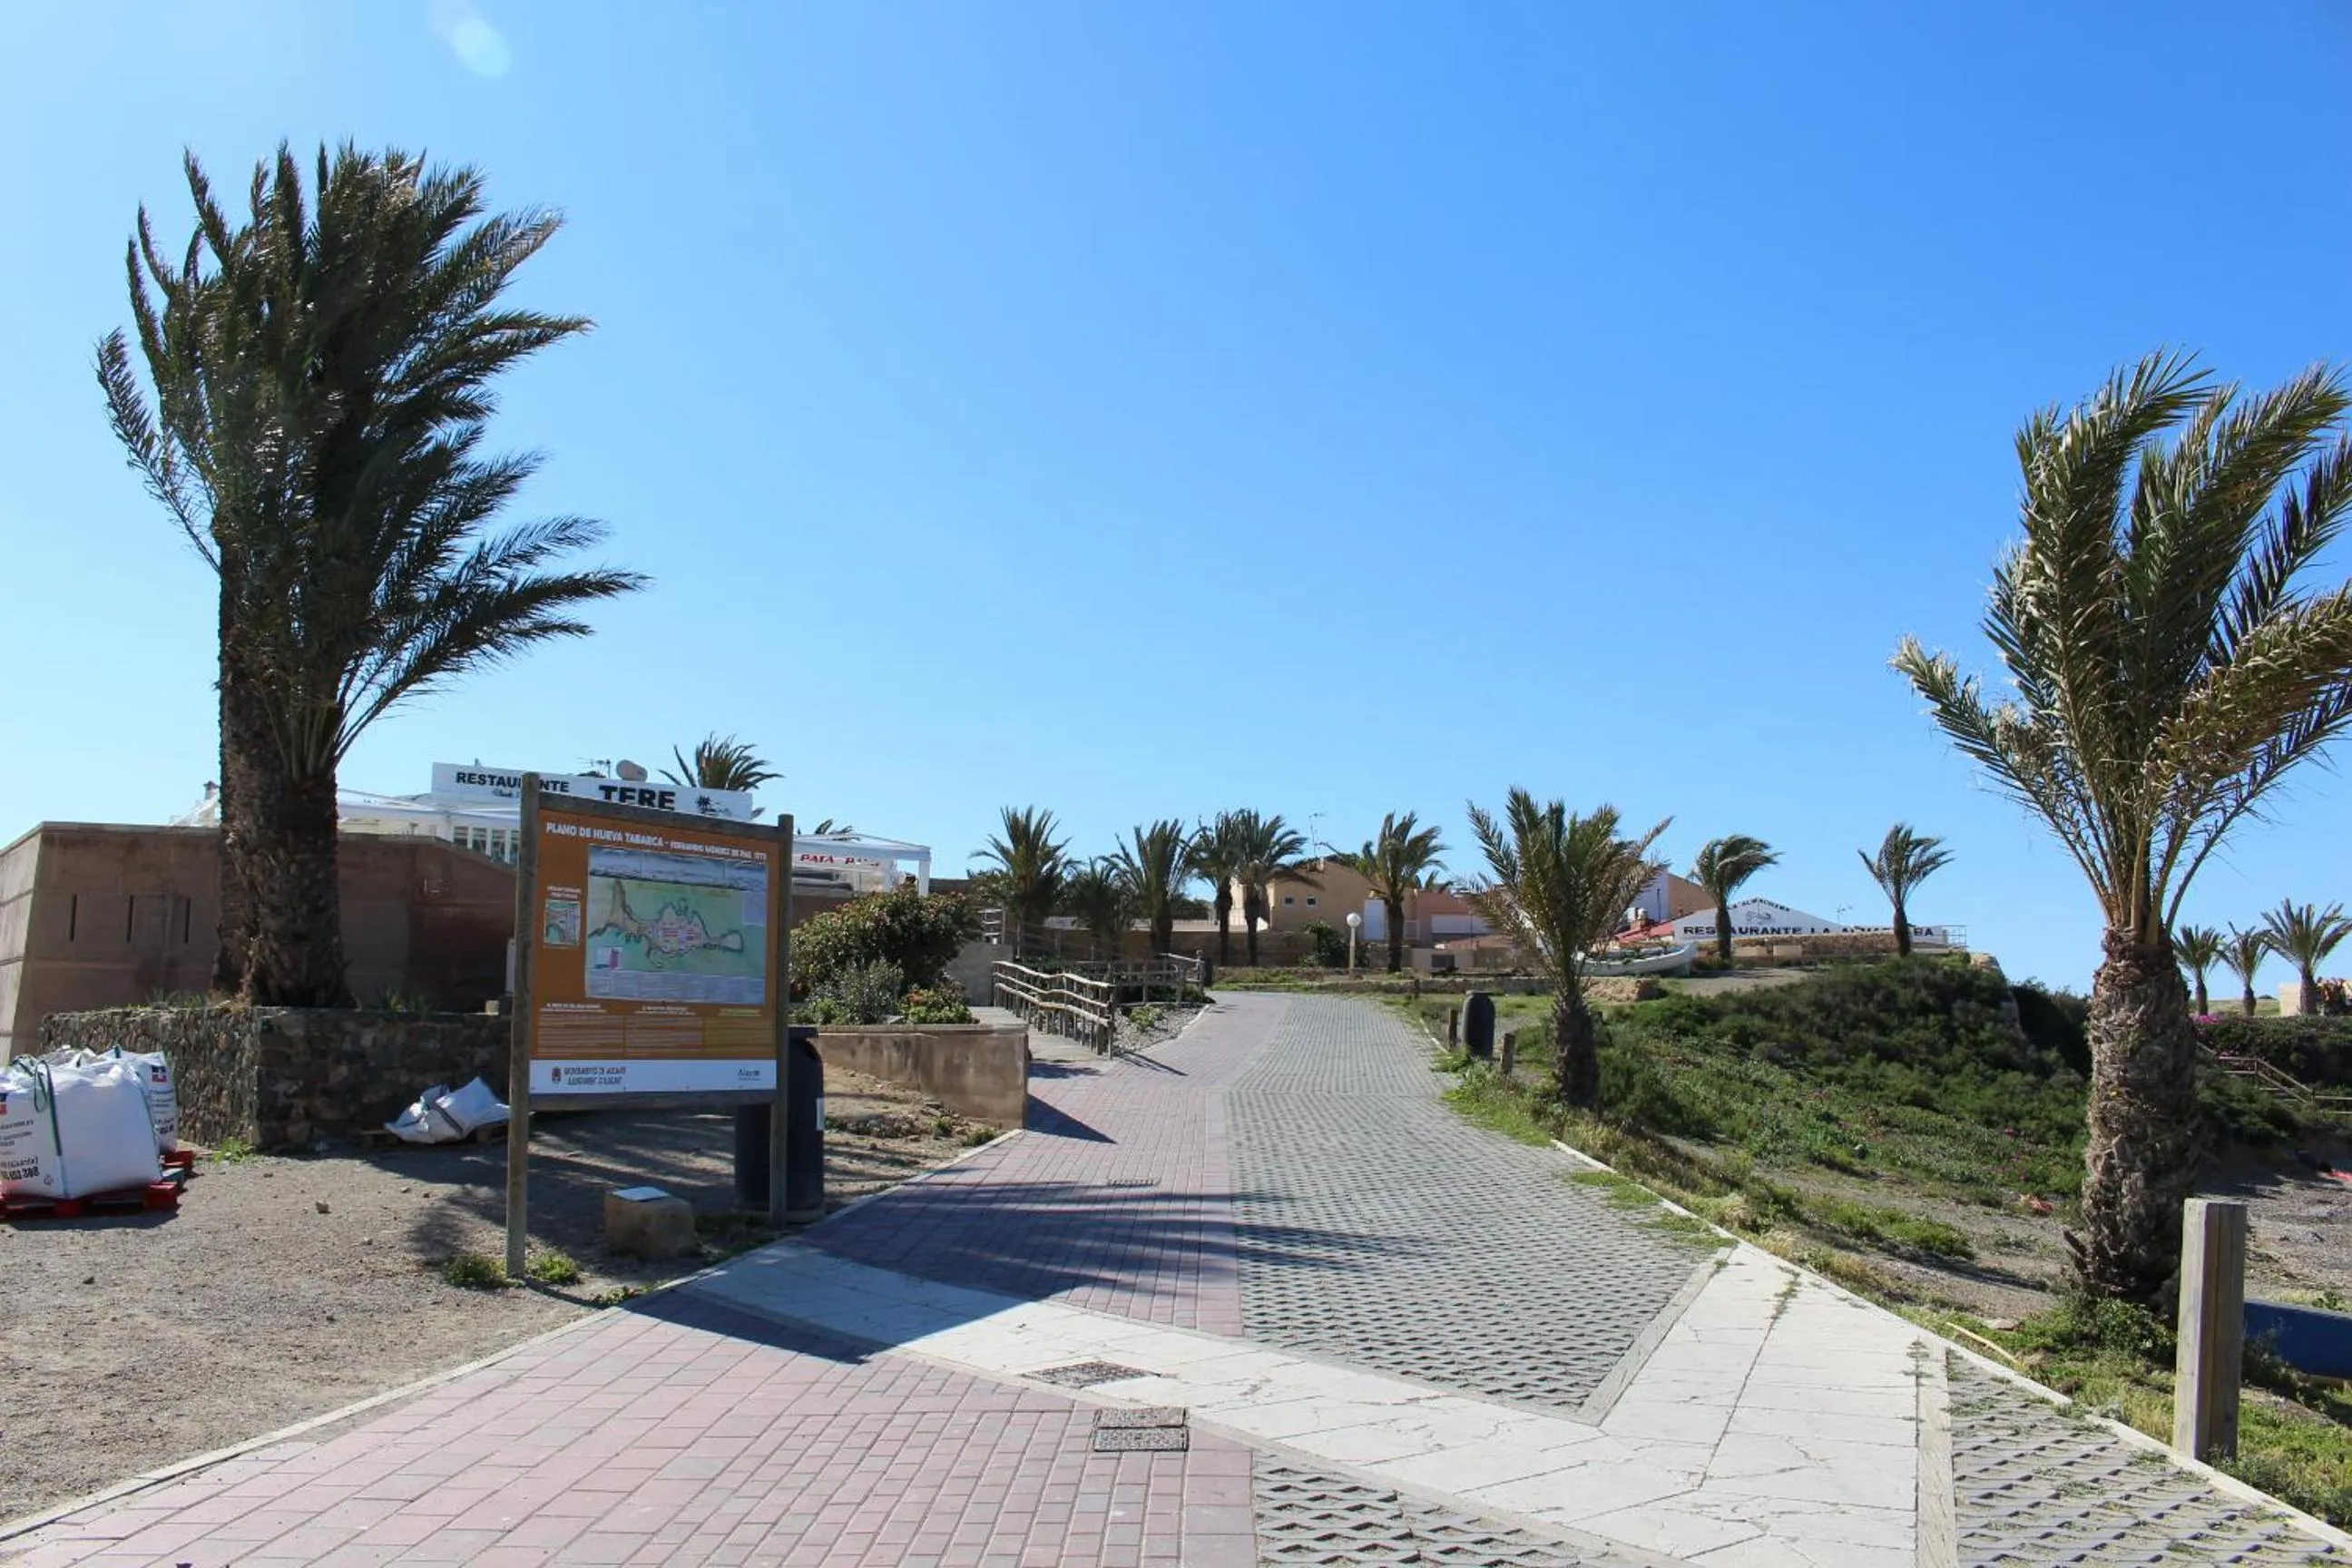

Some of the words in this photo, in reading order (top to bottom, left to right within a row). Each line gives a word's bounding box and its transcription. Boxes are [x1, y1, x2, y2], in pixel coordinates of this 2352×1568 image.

[456, 771, 570, 793] RESTAUNTE
[599, 785, 676, 810] TERE
[545, 821, 577, 837] PLANO
[579, 827, 592, 838] DE
[593, 828, 623, 842] NUEVA
[625, 832, 664, 847] TABARCA
[1683, 926, 1803, 936] RESAURANTE
